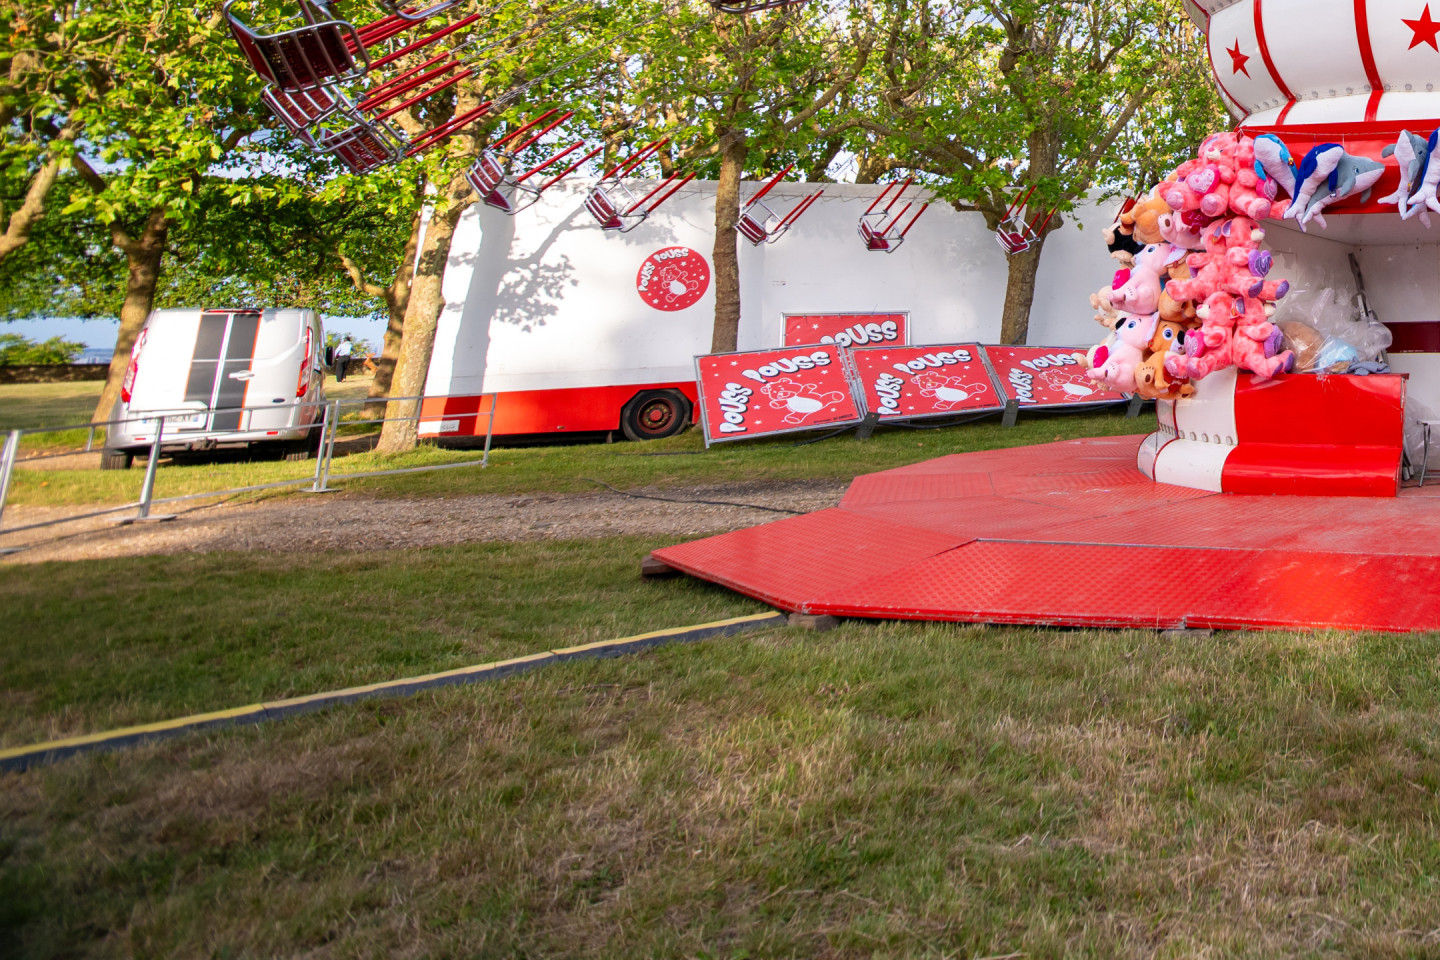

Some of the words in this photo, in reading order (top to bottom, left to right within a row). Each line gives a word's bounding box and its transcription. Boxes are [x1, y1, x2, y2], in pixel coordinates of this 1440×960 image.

[638, 261, 656, 292] POUSS
[653, 248, 689, 263] POUSS
[718, 382, 753, 433] POUSS
[741, 351, 832, 383] POUSS
[874, 372, 905, 415] POUSS
[892, 349, 972, 375] POUSS
